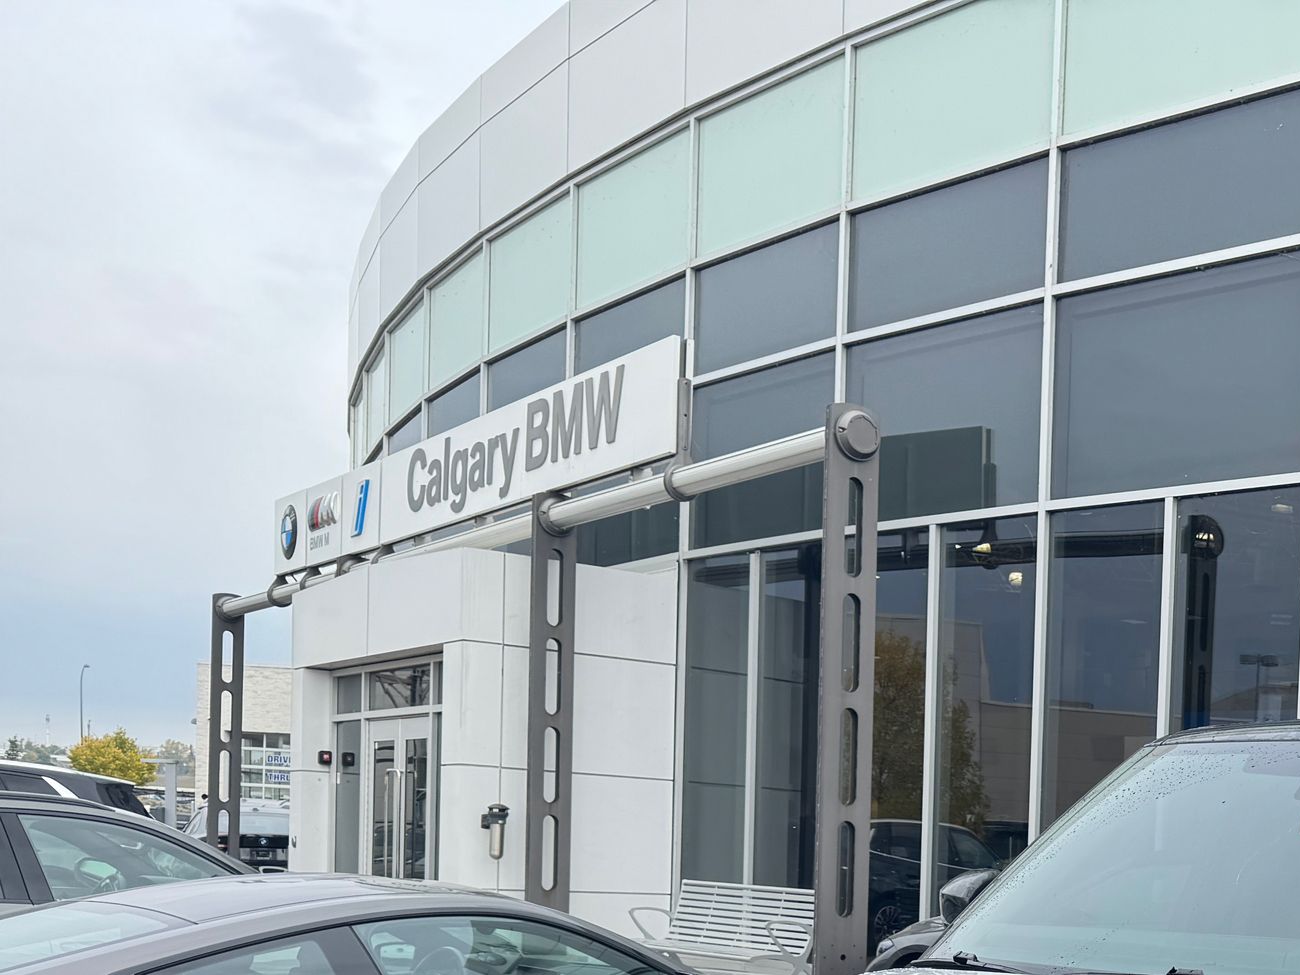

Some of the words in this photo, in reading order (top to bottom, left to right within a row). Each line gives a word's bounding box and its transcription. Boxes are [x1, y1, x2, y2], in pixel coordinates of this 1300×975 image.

[407, 428, 520, 513] Calgary
[525, 364, 625, 472] BMW
[310, 534, 323, 551] BMW
[324, 532, 330, 546] M
